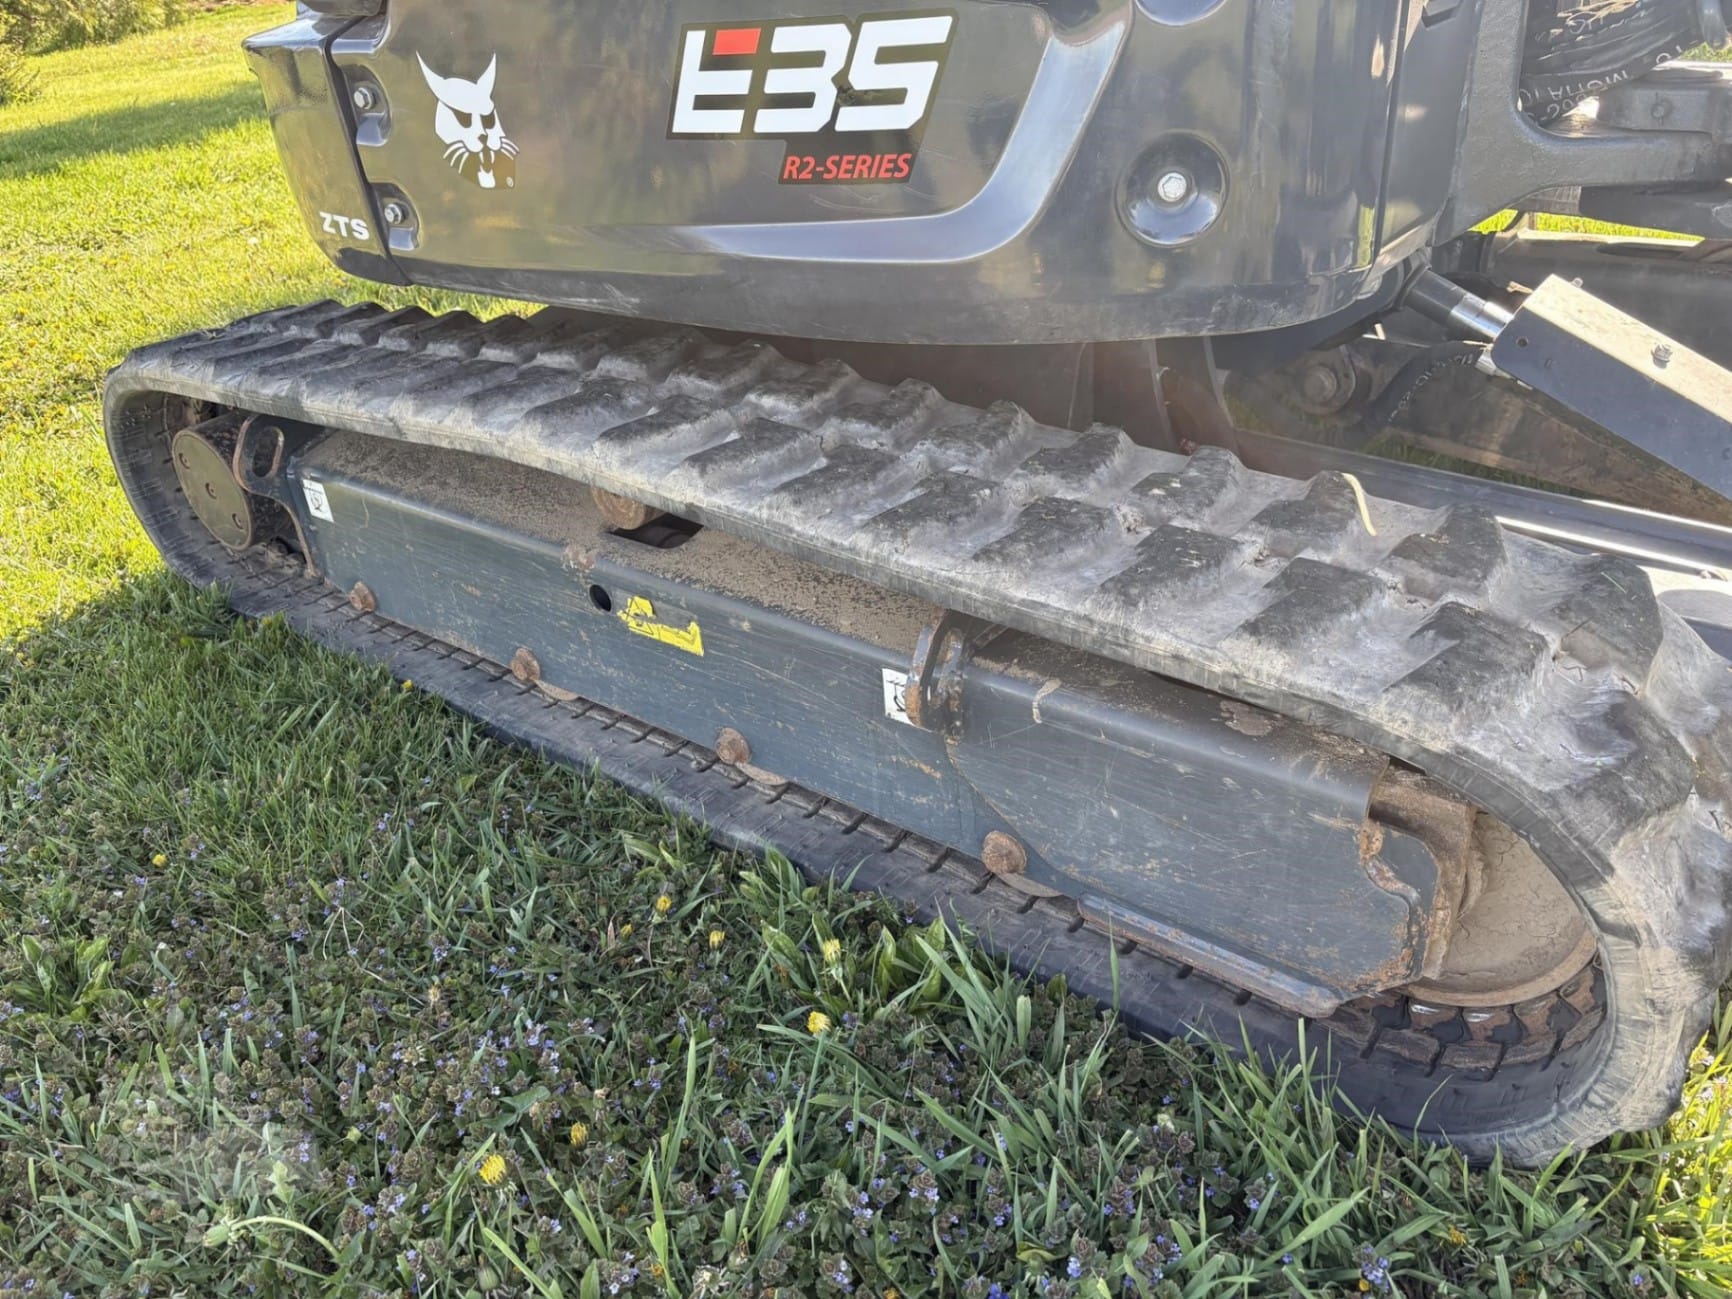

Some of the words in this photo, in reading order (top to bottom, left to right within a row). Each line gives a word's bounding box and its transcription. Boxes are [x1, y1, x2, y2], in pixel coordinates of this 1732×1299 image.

[671, 16, 953, 133] E35
[783, 153, 912, 179] R2-SERIES
[319, 211, 370, 240] ZTS
